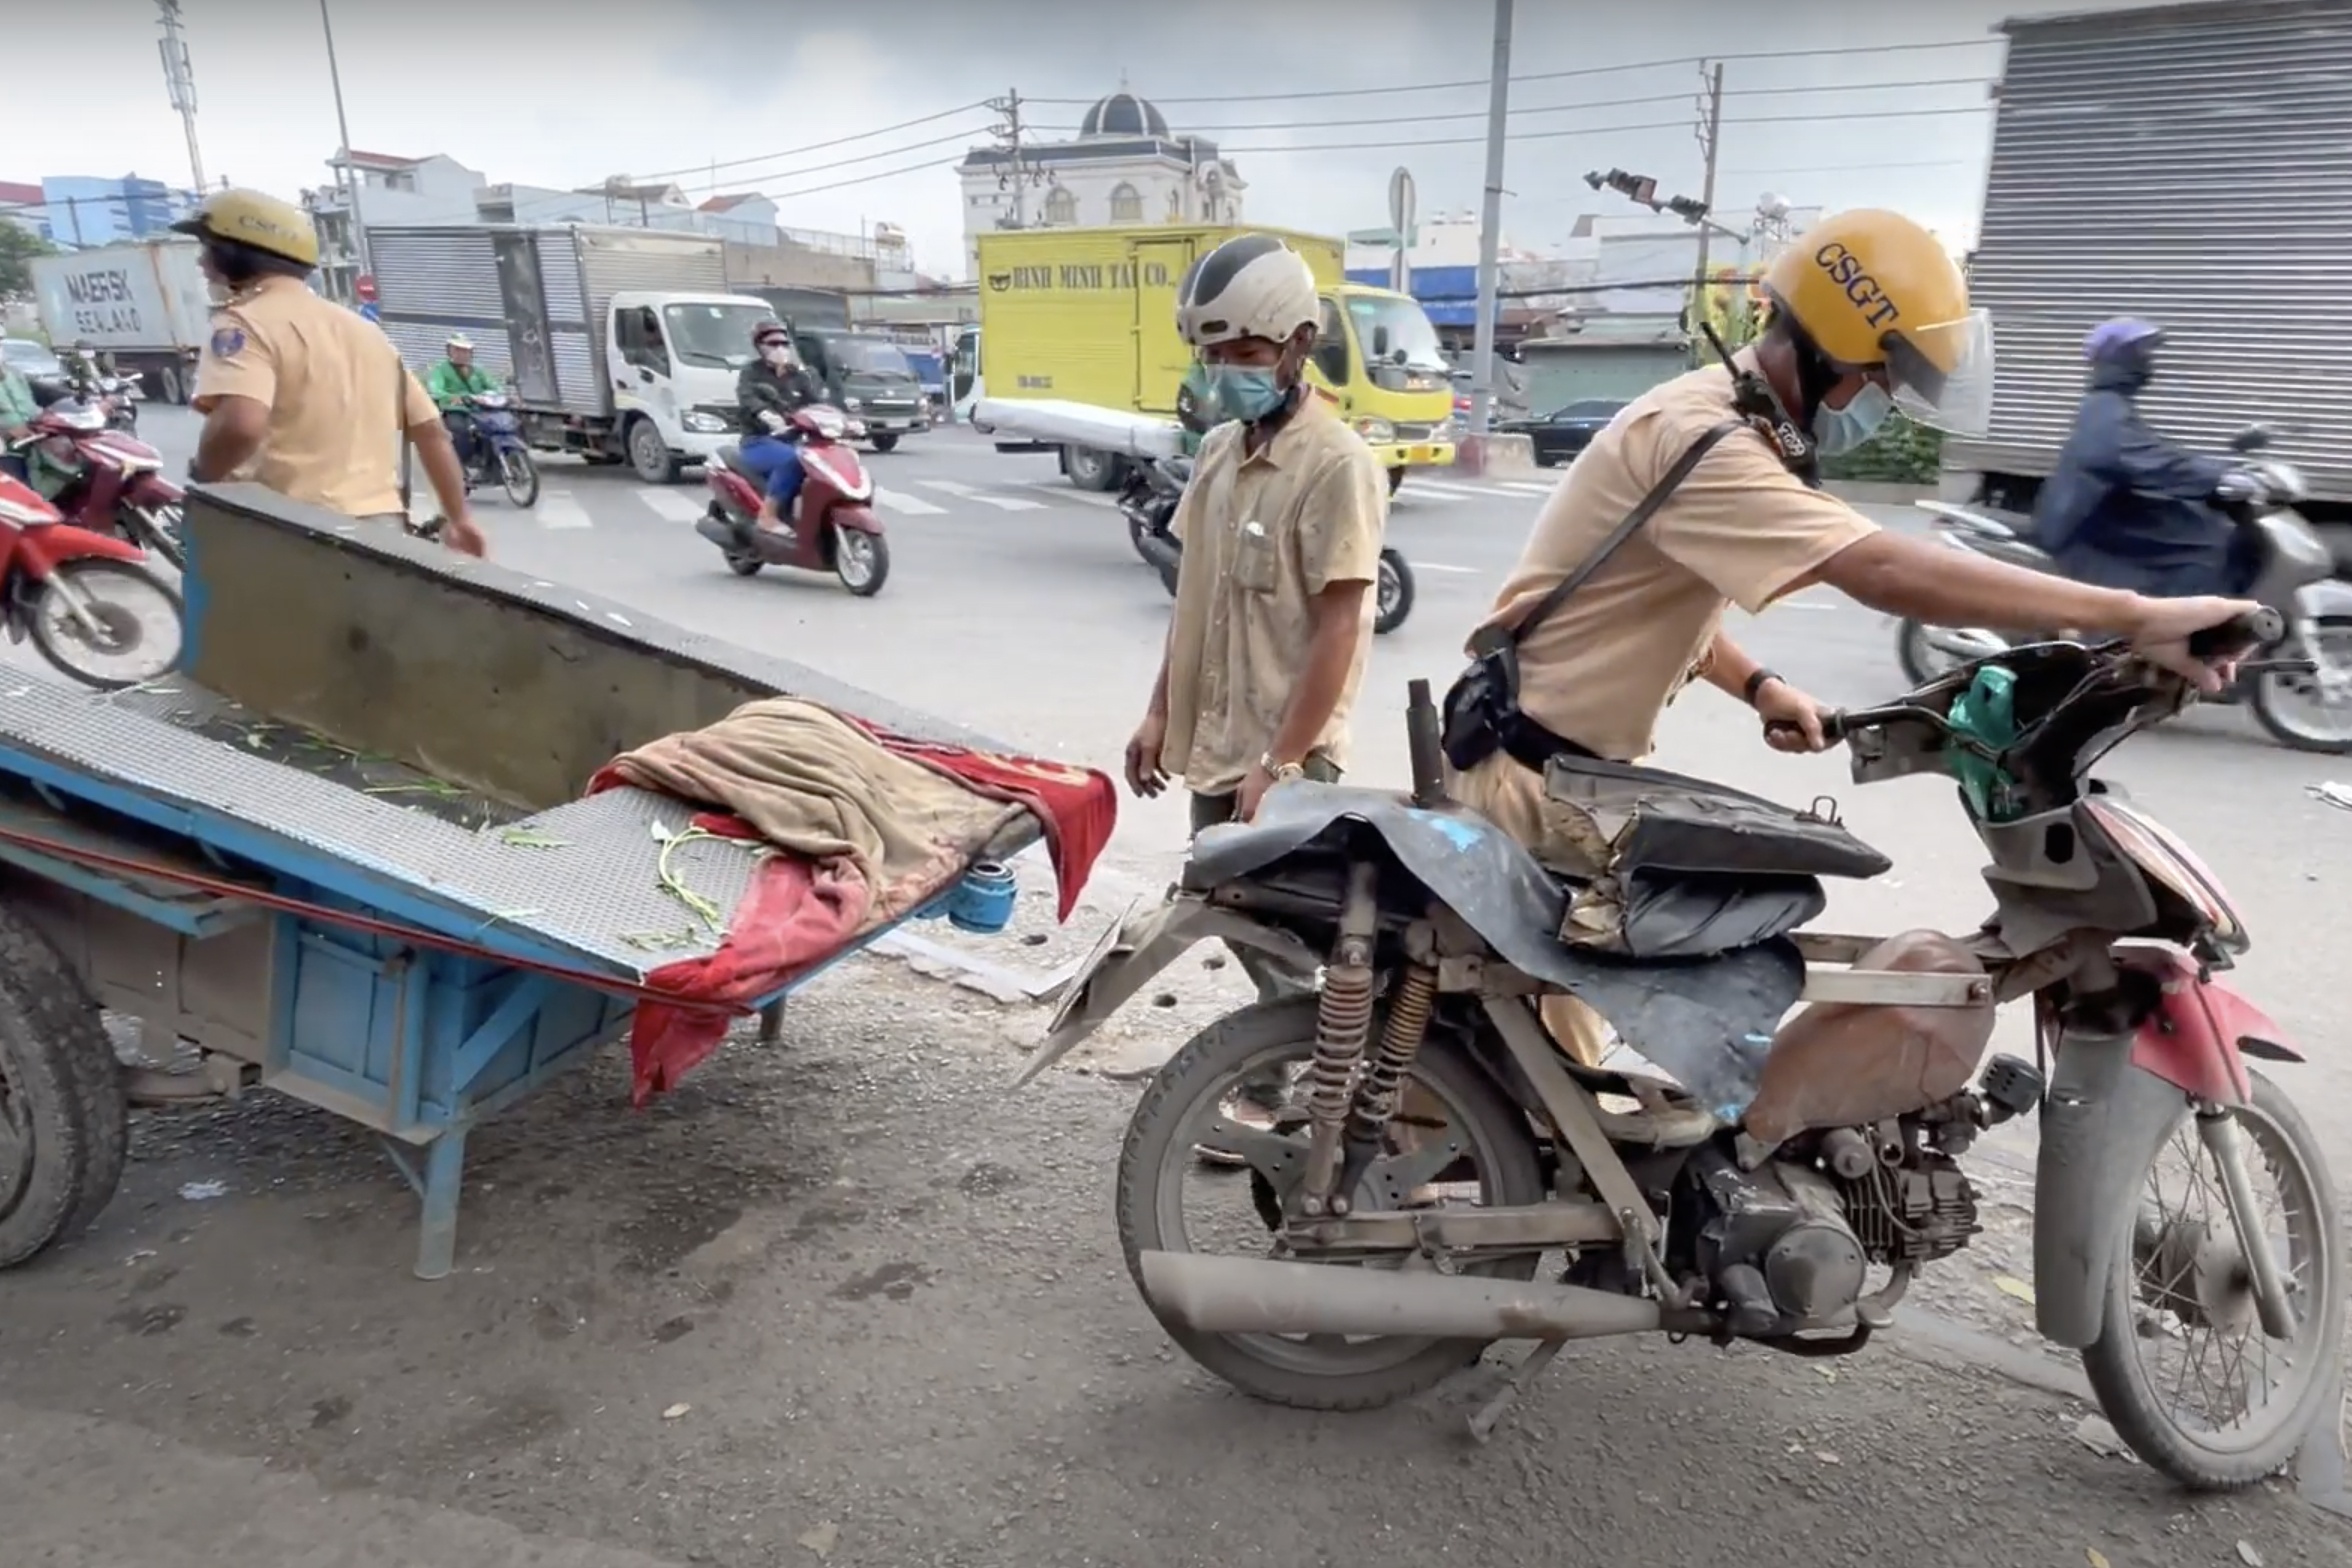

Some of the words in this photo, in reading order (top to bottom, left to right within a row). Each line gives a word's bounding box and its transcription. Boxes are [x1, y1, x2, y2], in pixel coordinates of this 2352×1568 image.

[1013, 264, 1052, 289] BINH
[1059, 263, 1103, 289] MINH
[1815, 243, 1899, 329] CSGT
